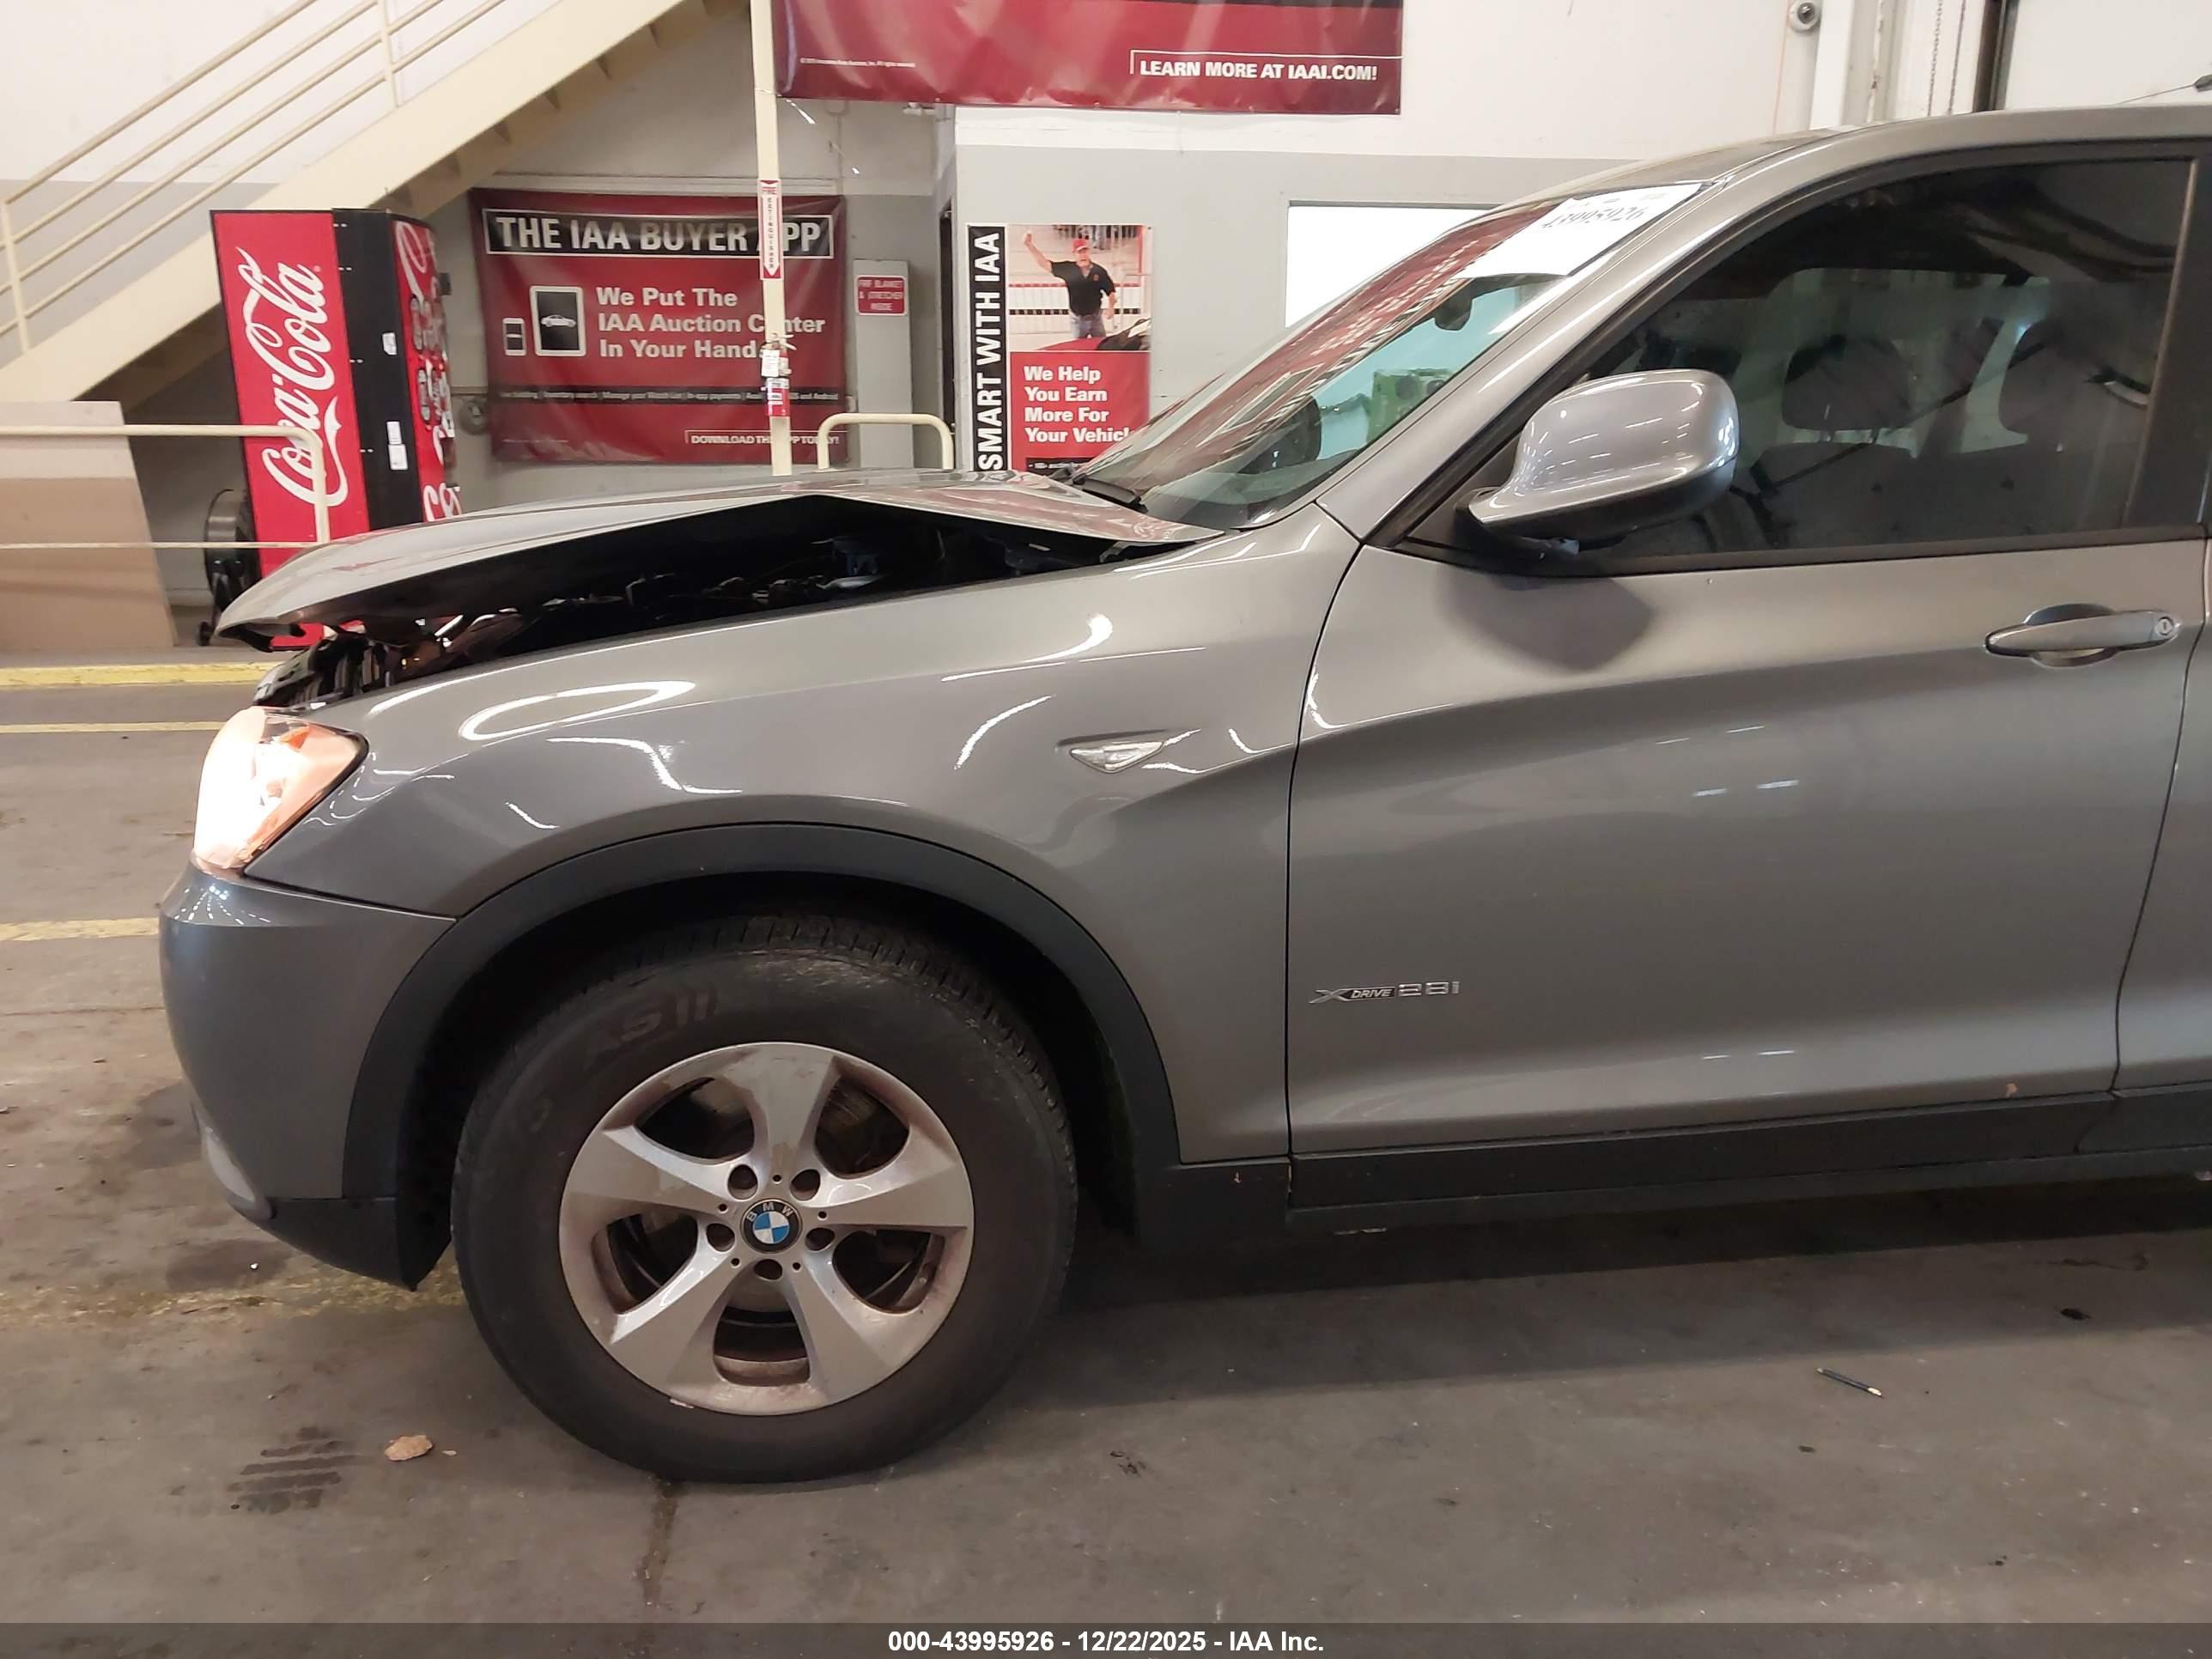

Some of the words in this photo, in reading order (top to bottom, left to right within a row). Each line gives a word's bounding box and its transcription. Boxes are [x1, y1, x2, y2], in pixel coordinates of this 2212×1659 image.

[1140, 60, 1200, 76] LEARN
[1205, 63, 1257, 78] MORE
[1260, 64, 1285, 79] AT
[1288, 64, 1377, 81] IAAI.COM!
[495, 216, 562, 249] THE
[570, 219, 631, 251] IAA
[639, 222, 748, 252] BUYER
[757, 222, 821, 252] PP
[974, 233, 1000, 282] IAA
[596, 287, 635, 306] We
[642, 288, 685, 307] Put
[691, 289, 738, 307] The
[598, 313, 644, 331] IAA
[649, 313, 742, 332] Auction
[748, 313, 826, 333] Cnter
[975, 292, 1002, 366] WITH
[599, 339, 623, 357] In
[629, 339, 687, 358] Your
[1023, 366, 1054, 381] We
[1058, 366, 1101, 385] Help
[1024, 386, 1060, 402] You
[1065, 386, 1108, 402] Earn
[976, 372, 1003, 471] SMART
[1024, 407, 1073, 422] More
[1078, 407, 1109, 422] For
[690, 434, 756, 445] DOWNLOAD
[756, 434, 771, 445] TH
[800, 435, 840, 445] TOY!
[1024, 428, 1069, 442] Your
[746, 1201, 794, 1223] BMW
